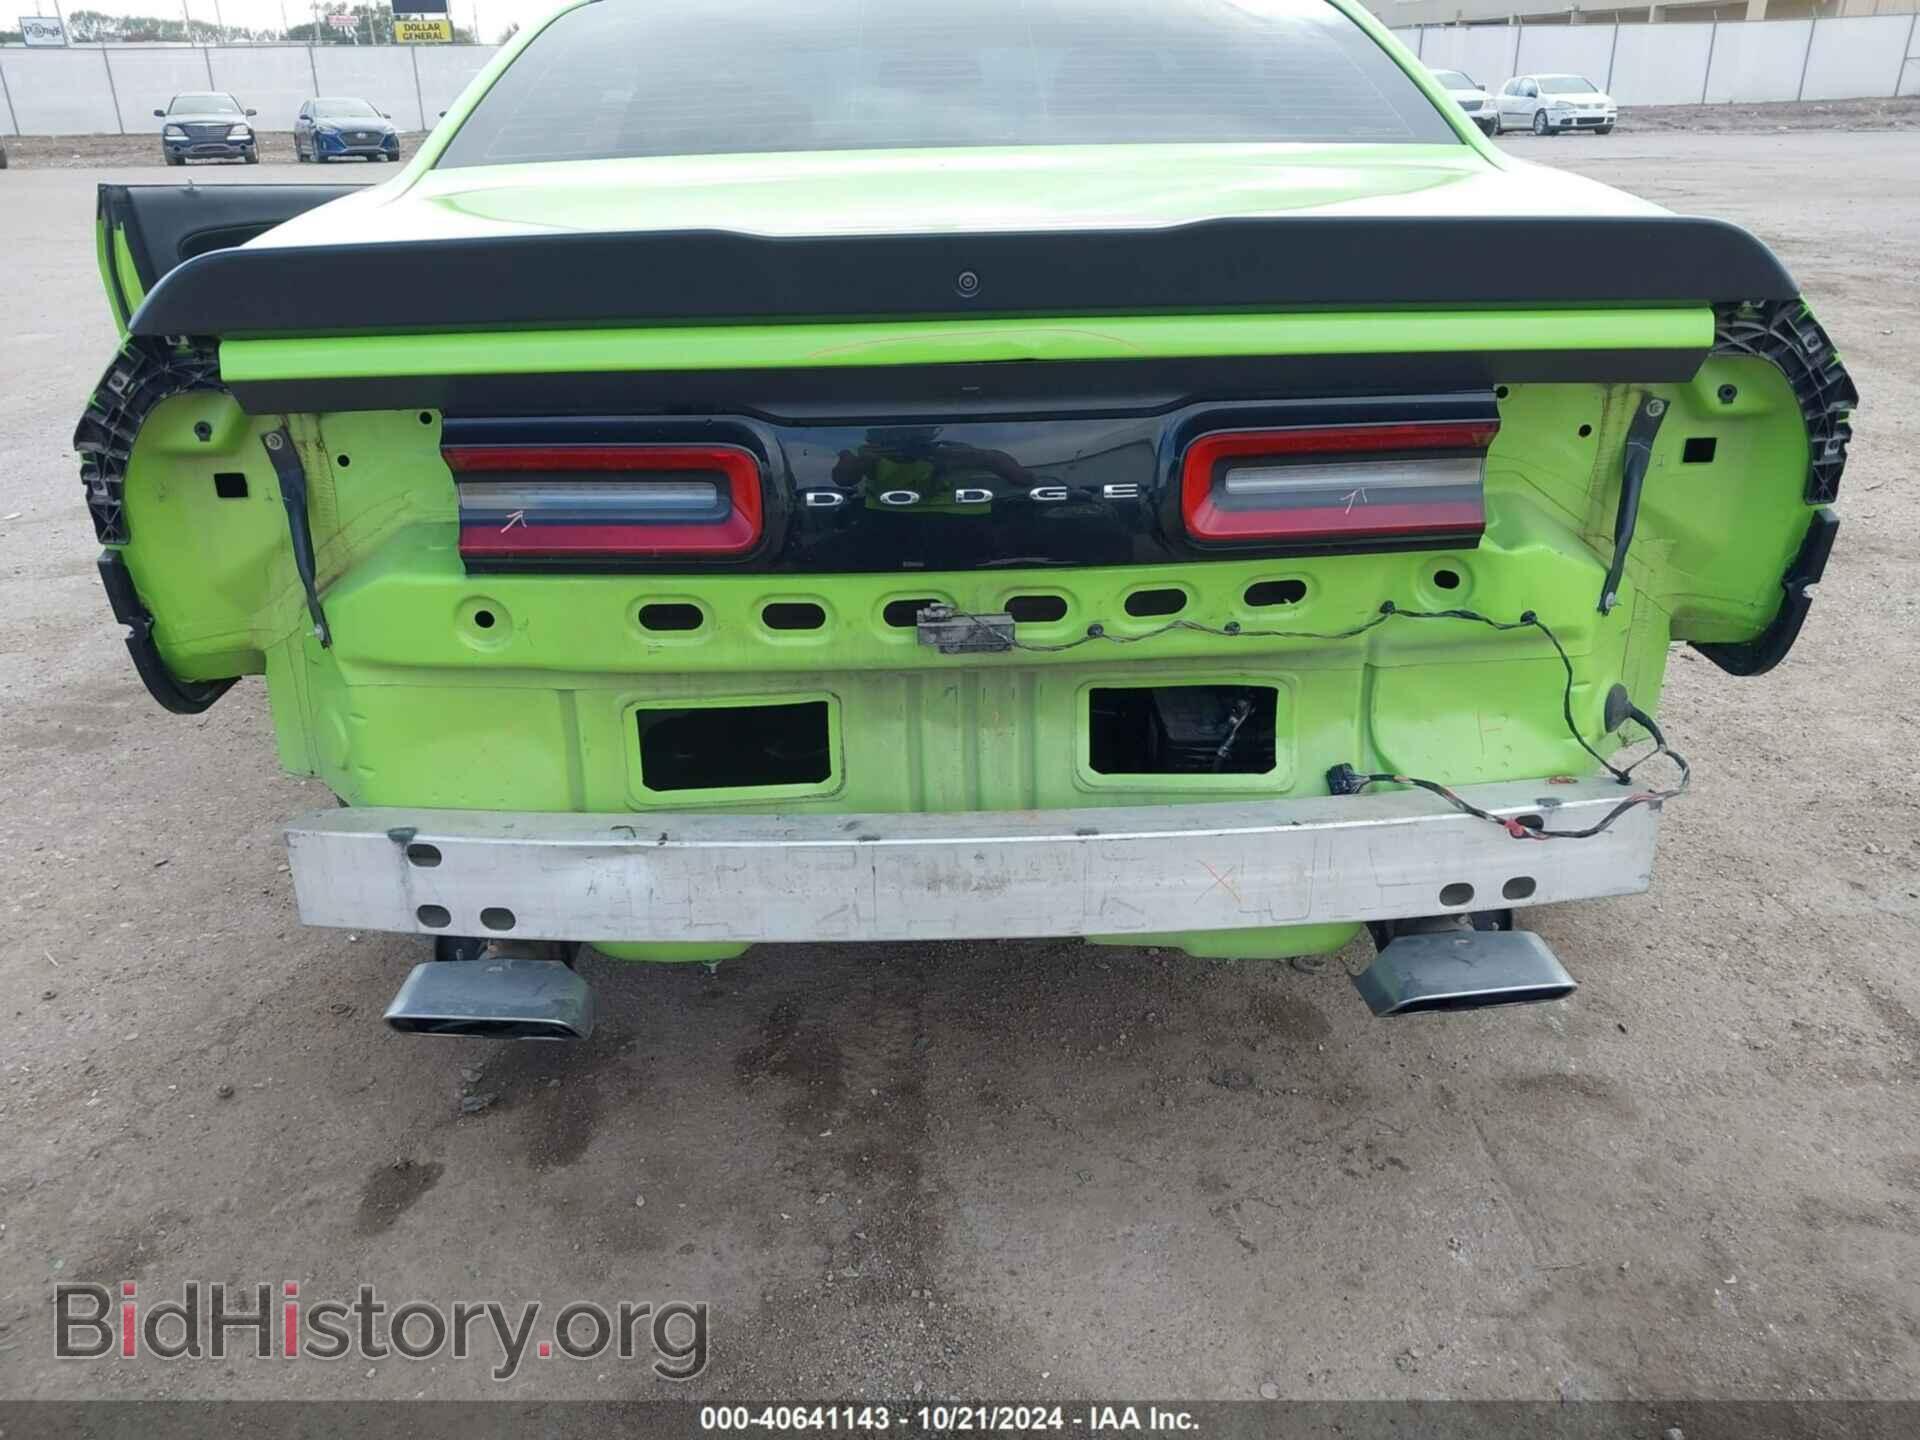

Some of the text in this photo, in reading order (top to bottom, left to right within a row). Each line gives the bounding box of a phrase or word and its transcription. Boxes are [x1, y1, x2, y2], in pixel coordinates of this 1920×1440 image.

[404, 23, 441, 32] DOLLAR
[402, 32, 444, 40] GENERAL
[806, 483, 1138, 506] DODGE
